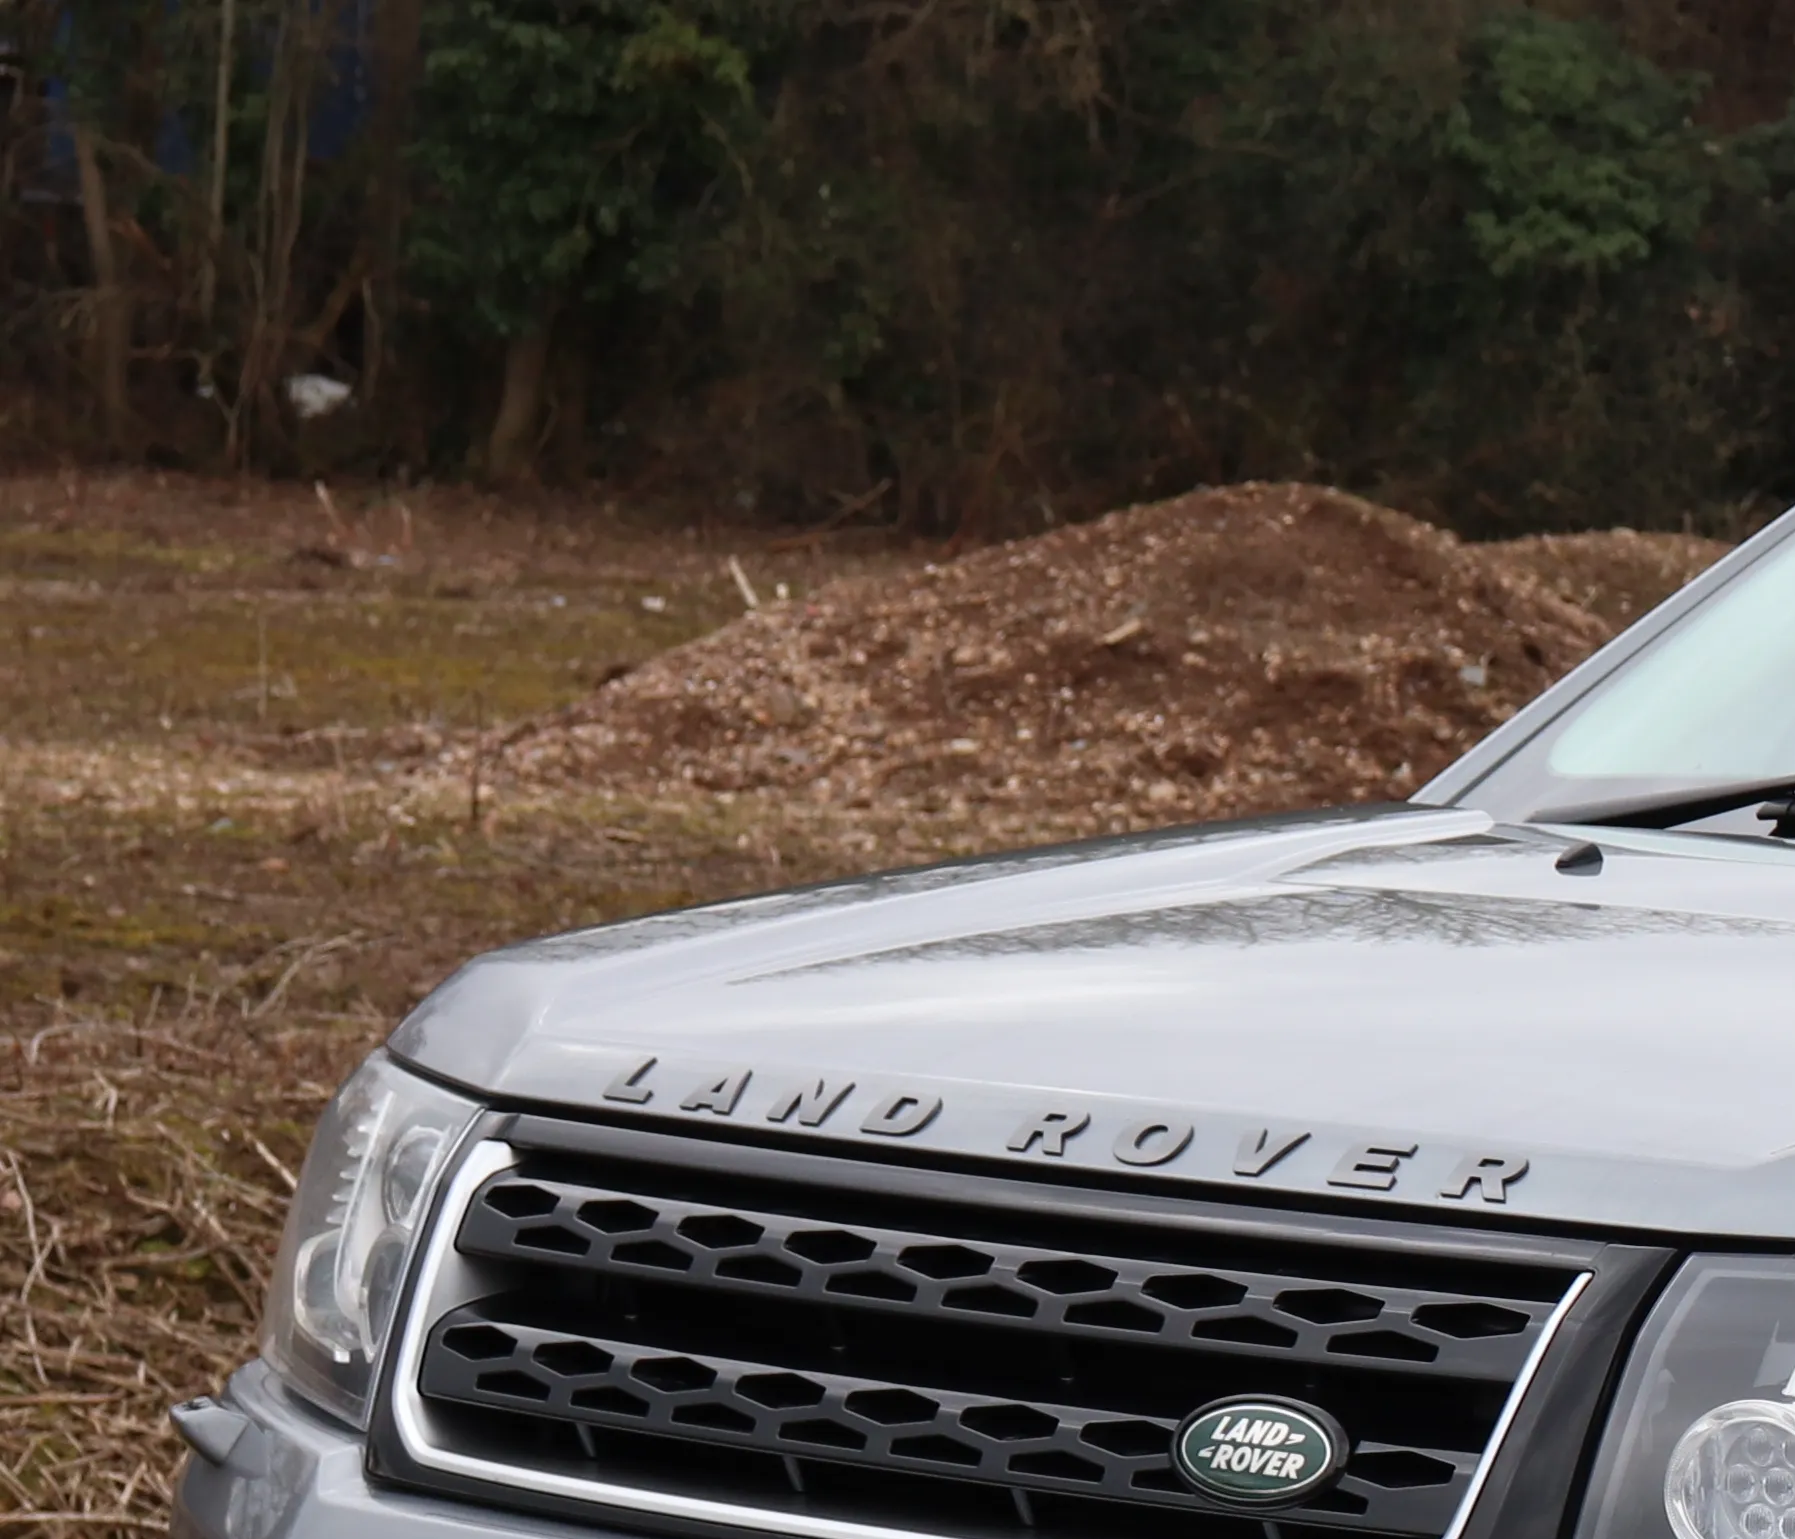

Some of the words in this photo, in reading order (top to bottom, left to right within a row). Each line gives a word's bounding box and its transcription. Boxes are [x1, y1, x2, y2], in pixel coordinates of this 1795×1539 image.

[602, 1056, 944, 1137] LAND
[1005, 1110, 1530, 1205] ROVER
[1211, 1415, 1290, 1447] LAND
[1209, 1443, 1305, 1480] ROVER
